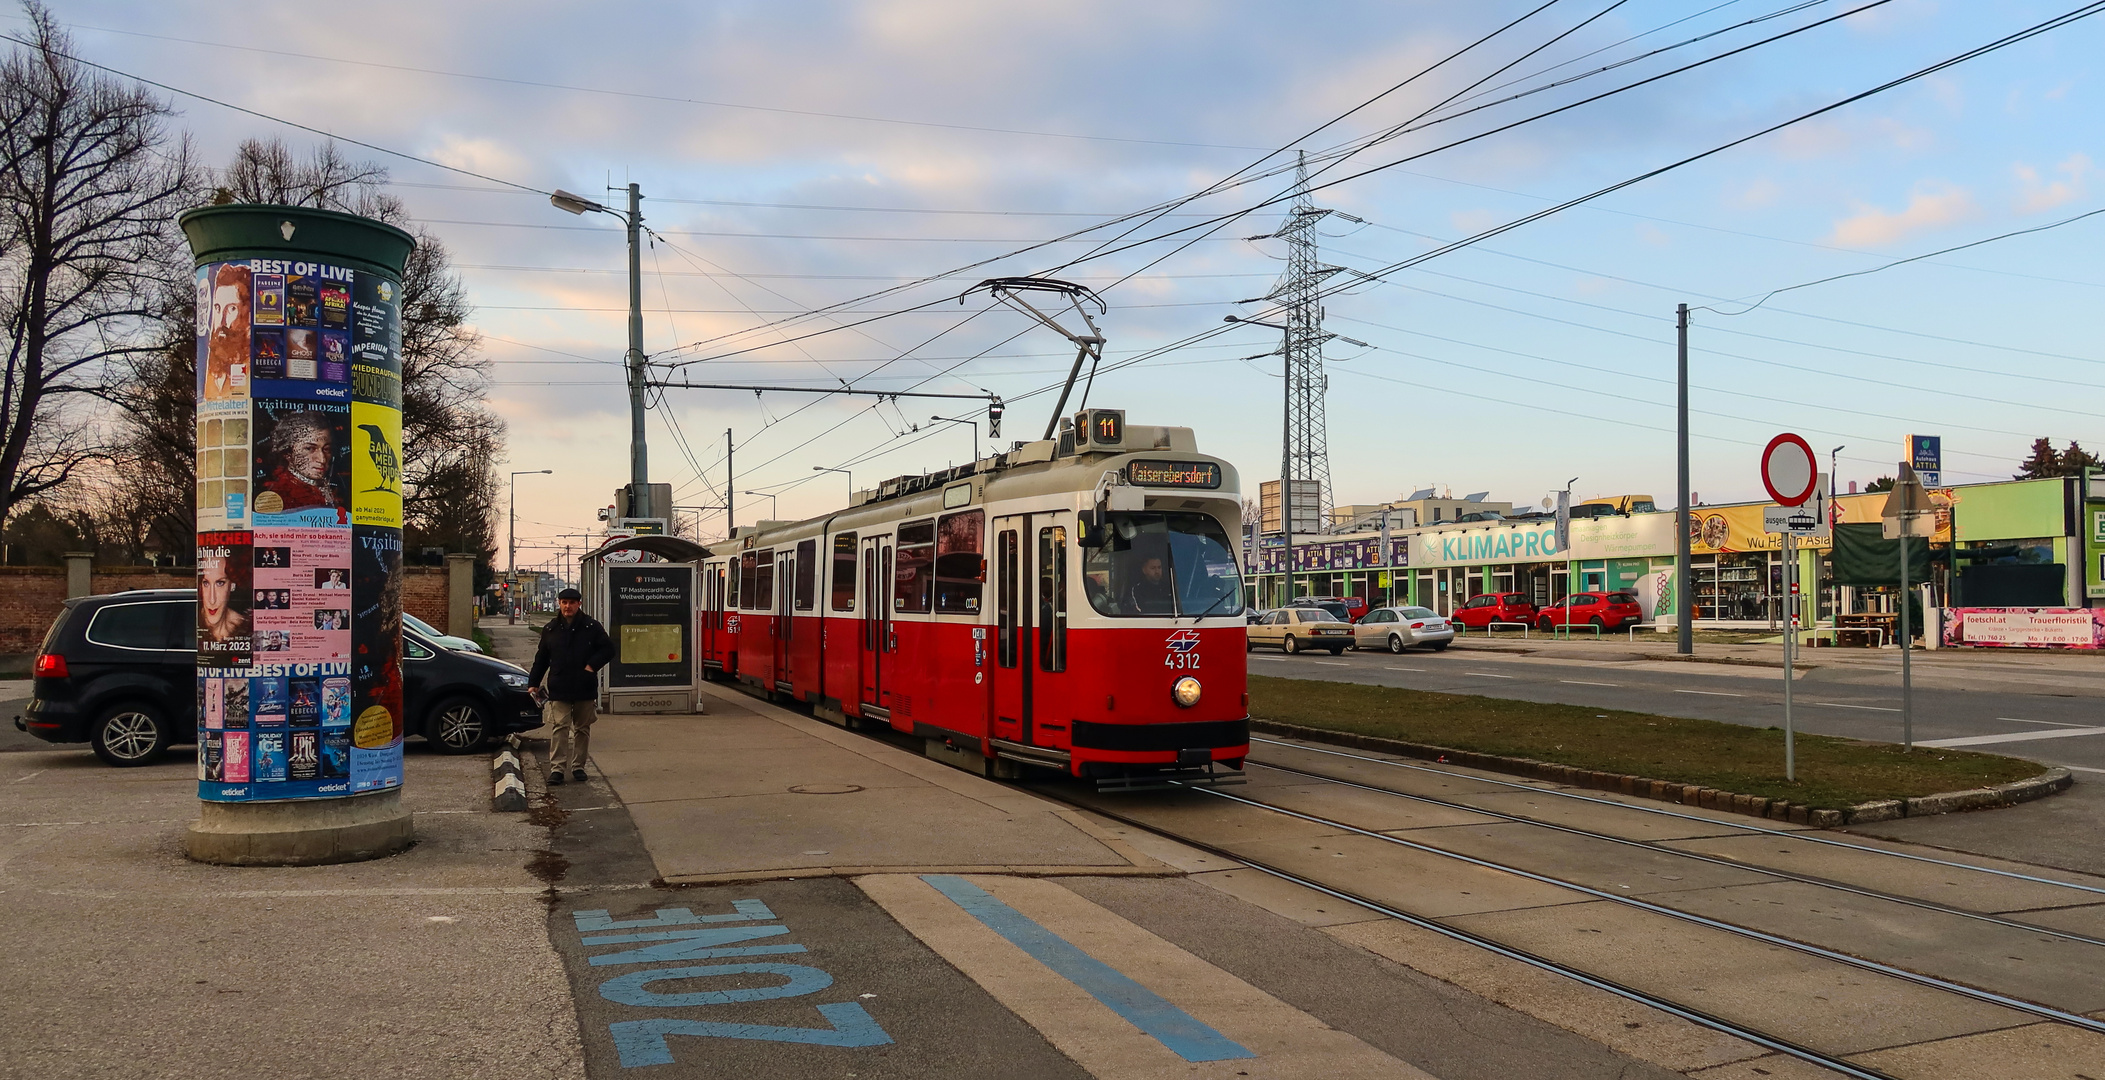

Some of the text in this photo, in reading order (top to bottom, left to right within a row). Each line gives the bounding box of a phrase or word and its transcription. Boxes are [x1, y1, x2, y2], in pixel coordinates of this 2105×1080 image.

[251, 259, 354, 283] BEST OF LIVE
[351, 342, 389, 354] IMPERIUM
[255, 358, 282, 366] REBECCA
[315, 387, 345, 397] oeticket
[257, 398, 350, 414] visiting mozart
[1099, 417, 1115, 438] 11
[369, 441, 393, 454] GANY
[375, 453, 393, 466] MED
[1915, 461, 1938, 470] ATTIA
[1131, 462, 1213, 485] Kaiserebersdorf
[299, 515, 334, 524] MOZART
[1765, 517, 1788, 526] ausgen.
[254, 532, 268, 541] Ach,
[269, 532, 279, 540] sie
[280, 532, 295, 540] sind
[1580, 531, 1638, 544] Designheizkörper
[1746, 537, 1765, 549] Wu
[1805, 535, 1831, 546] Asia
[1365, 545, 1381, 554] ATTI
[1442, 529, 1558, 562] KLIMAPRO
[1604, 543, 1657, 553] Wärmepumpen
[214, 545, 231, 558] die
[1306, 549, 1324, 558] ATTIA
[645, 593, 681, 602] gebührenfrei
[1966, 616, 2088, 625] foetschl.at Trauerfloristik
[727, 626, 739, 634] 151
[1978, 634, 1987, 642] (1)
[210, 640, 228, 651] März
[229, 641, 251, 651] 2023
[1164, 652, 1201, 670] 4312
[252, 662, 293, 678] BEST
[294, 662, 319, 677] OF
[258, 740, 284, 752] ICE
[318, 783, 347, 792] oeticket
[572, 898, 895, 1069] ZONE
